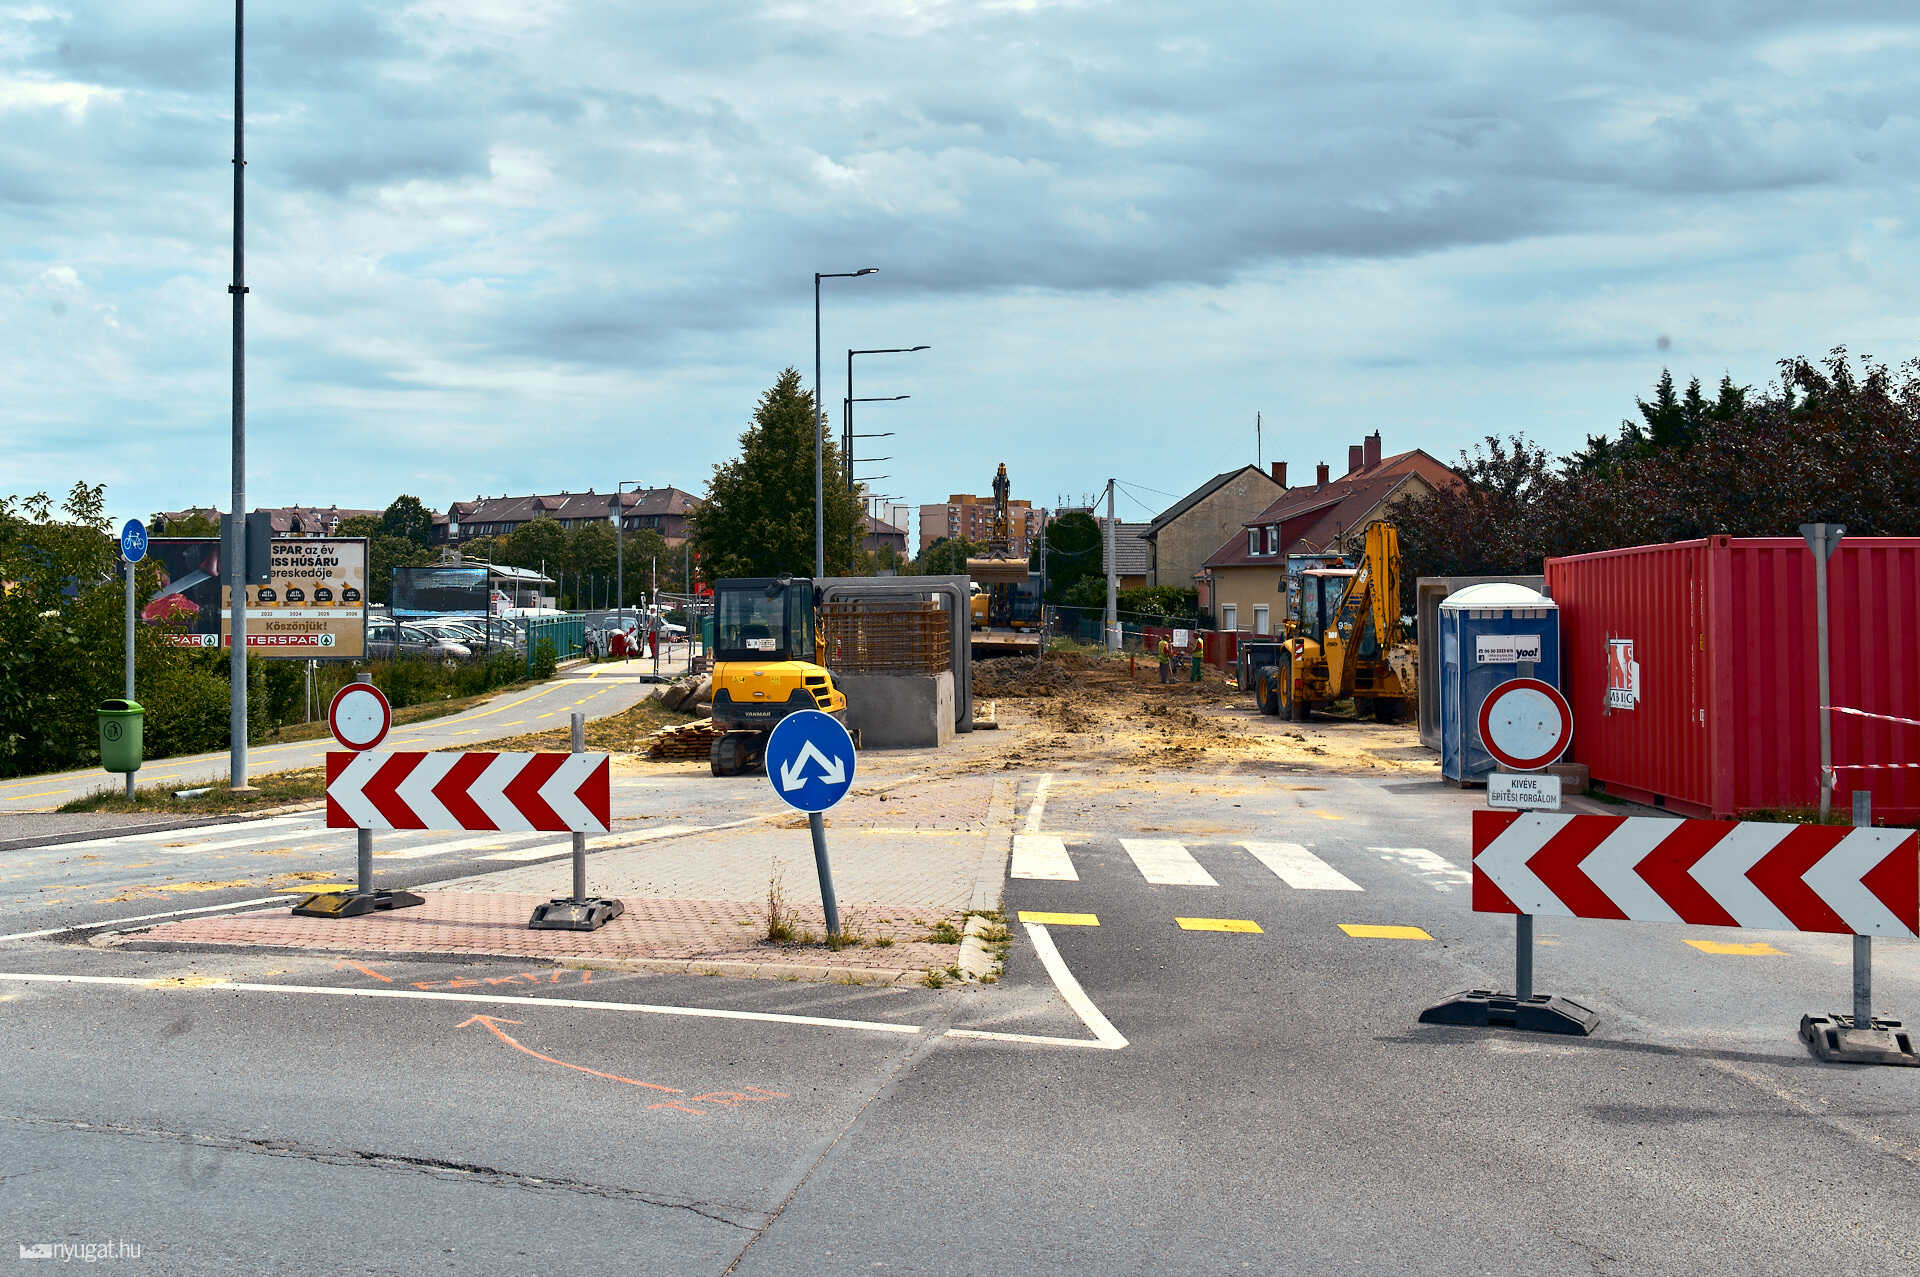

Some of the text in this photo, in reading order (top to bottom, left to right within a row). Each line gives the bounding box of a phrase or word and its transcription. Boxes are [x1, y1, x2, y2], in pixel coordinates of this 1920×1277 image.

[272, 544, 335, 555] SPAR az év
[271, 554, 339, 567] ISS HÚSÁRU
[270, 567, 333, 580] ereskedője
[265, 621, 328, 633] Köszönjük!
[247, 636, 318, 644] TERSPAR
[1511, 777, 1537, 789] KIVÉVE
[1491, 790, 1557, 804] ÉPÍTÉSI FORGALOM
